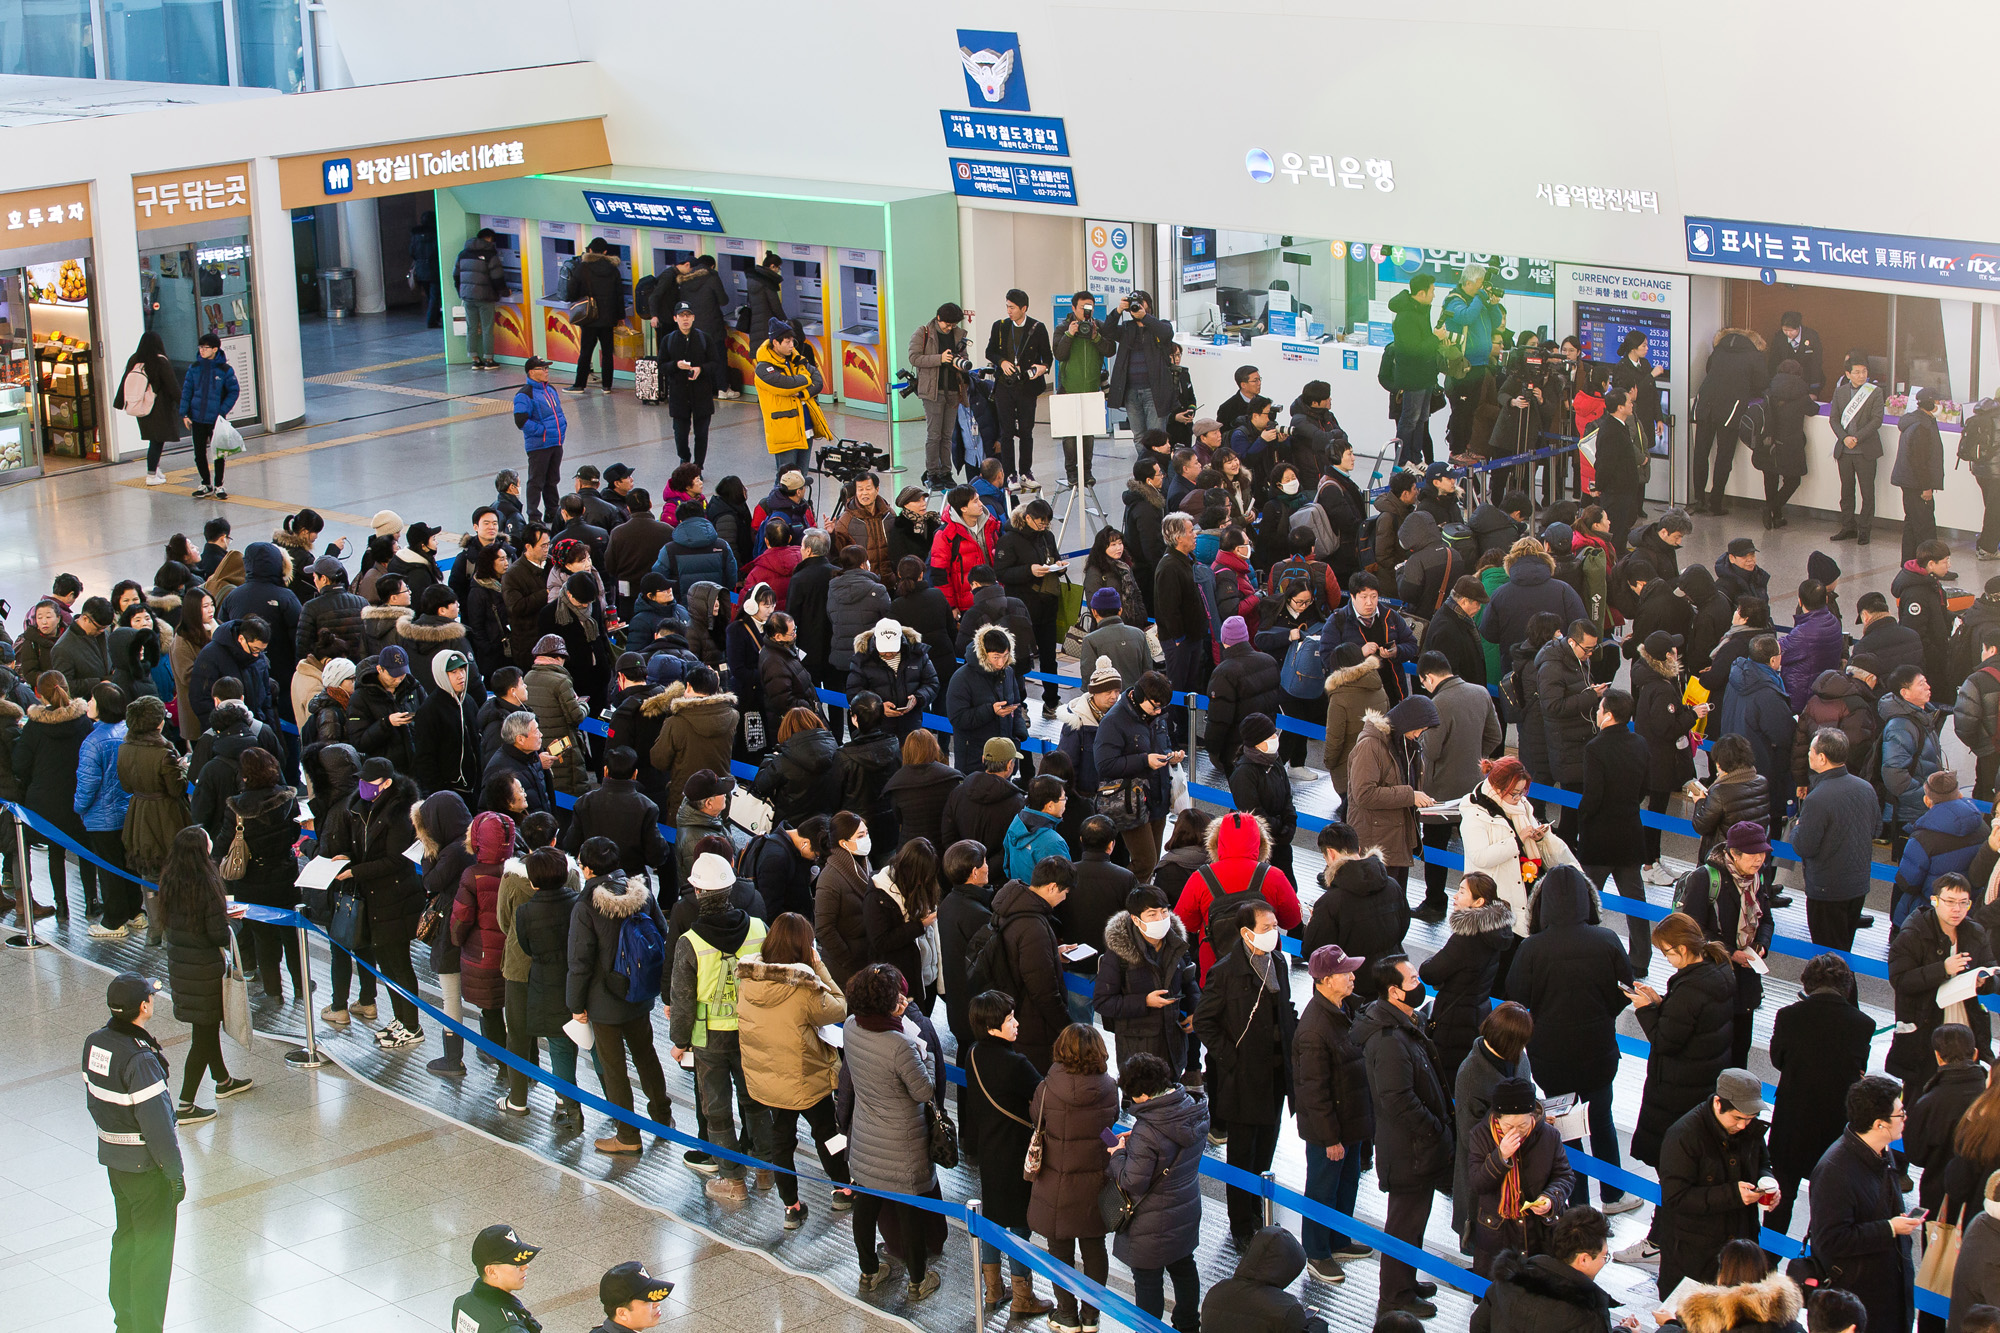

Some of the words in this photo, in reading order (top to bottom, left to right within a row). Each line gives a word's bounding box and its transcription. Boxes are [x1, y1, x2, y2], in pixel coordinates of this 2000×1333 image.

[952, 122, 1058, 144] 서울지방철도경찰대
[356, 155, 411, 184] 화장실
[418, 149, 470, 176] Toilet
[478, 141, 524, 169] 化粧室
[971, 164, 1010, 178] 고객지원실
[1030, 170, 1069, 184] 유실물센터
[1280, 151, 1395, 193] 우리은행
[136, 175, 247, 217] 구두닦는곳
[1536, 183, 1659, 214] 서울역환전센터
[7, 202, 84, 230] 호두과자
[607, 200, 632, 213] 승차권
[632, 202, 674, 217] 자동발매기
[196, 246, 244, 265] 구두닦는곳
[1721, 229, 1783, 260] 표사는
[1792, 236, 1810, 263] 곳
[1818, 241, 1868, 265] Ticket
[1875, 247, 1916, 270] 買票所
[1528, 268, 1554, 285] 서울
[1572, 272, 1620, 285] CURRENCY
[1622, 277, 1672, 290] EXCHANGE
[1764, 272, 1770, 282] 1
[1649, 329, 1669, 338] 255.28
[1299, 346, 1319, 354] EXCHANGE
[1649, 339, 1669, 348] 827.58
[1652, 349, 1669, 358] 35.32
[1652, 359, 1669, 368] 22.79
